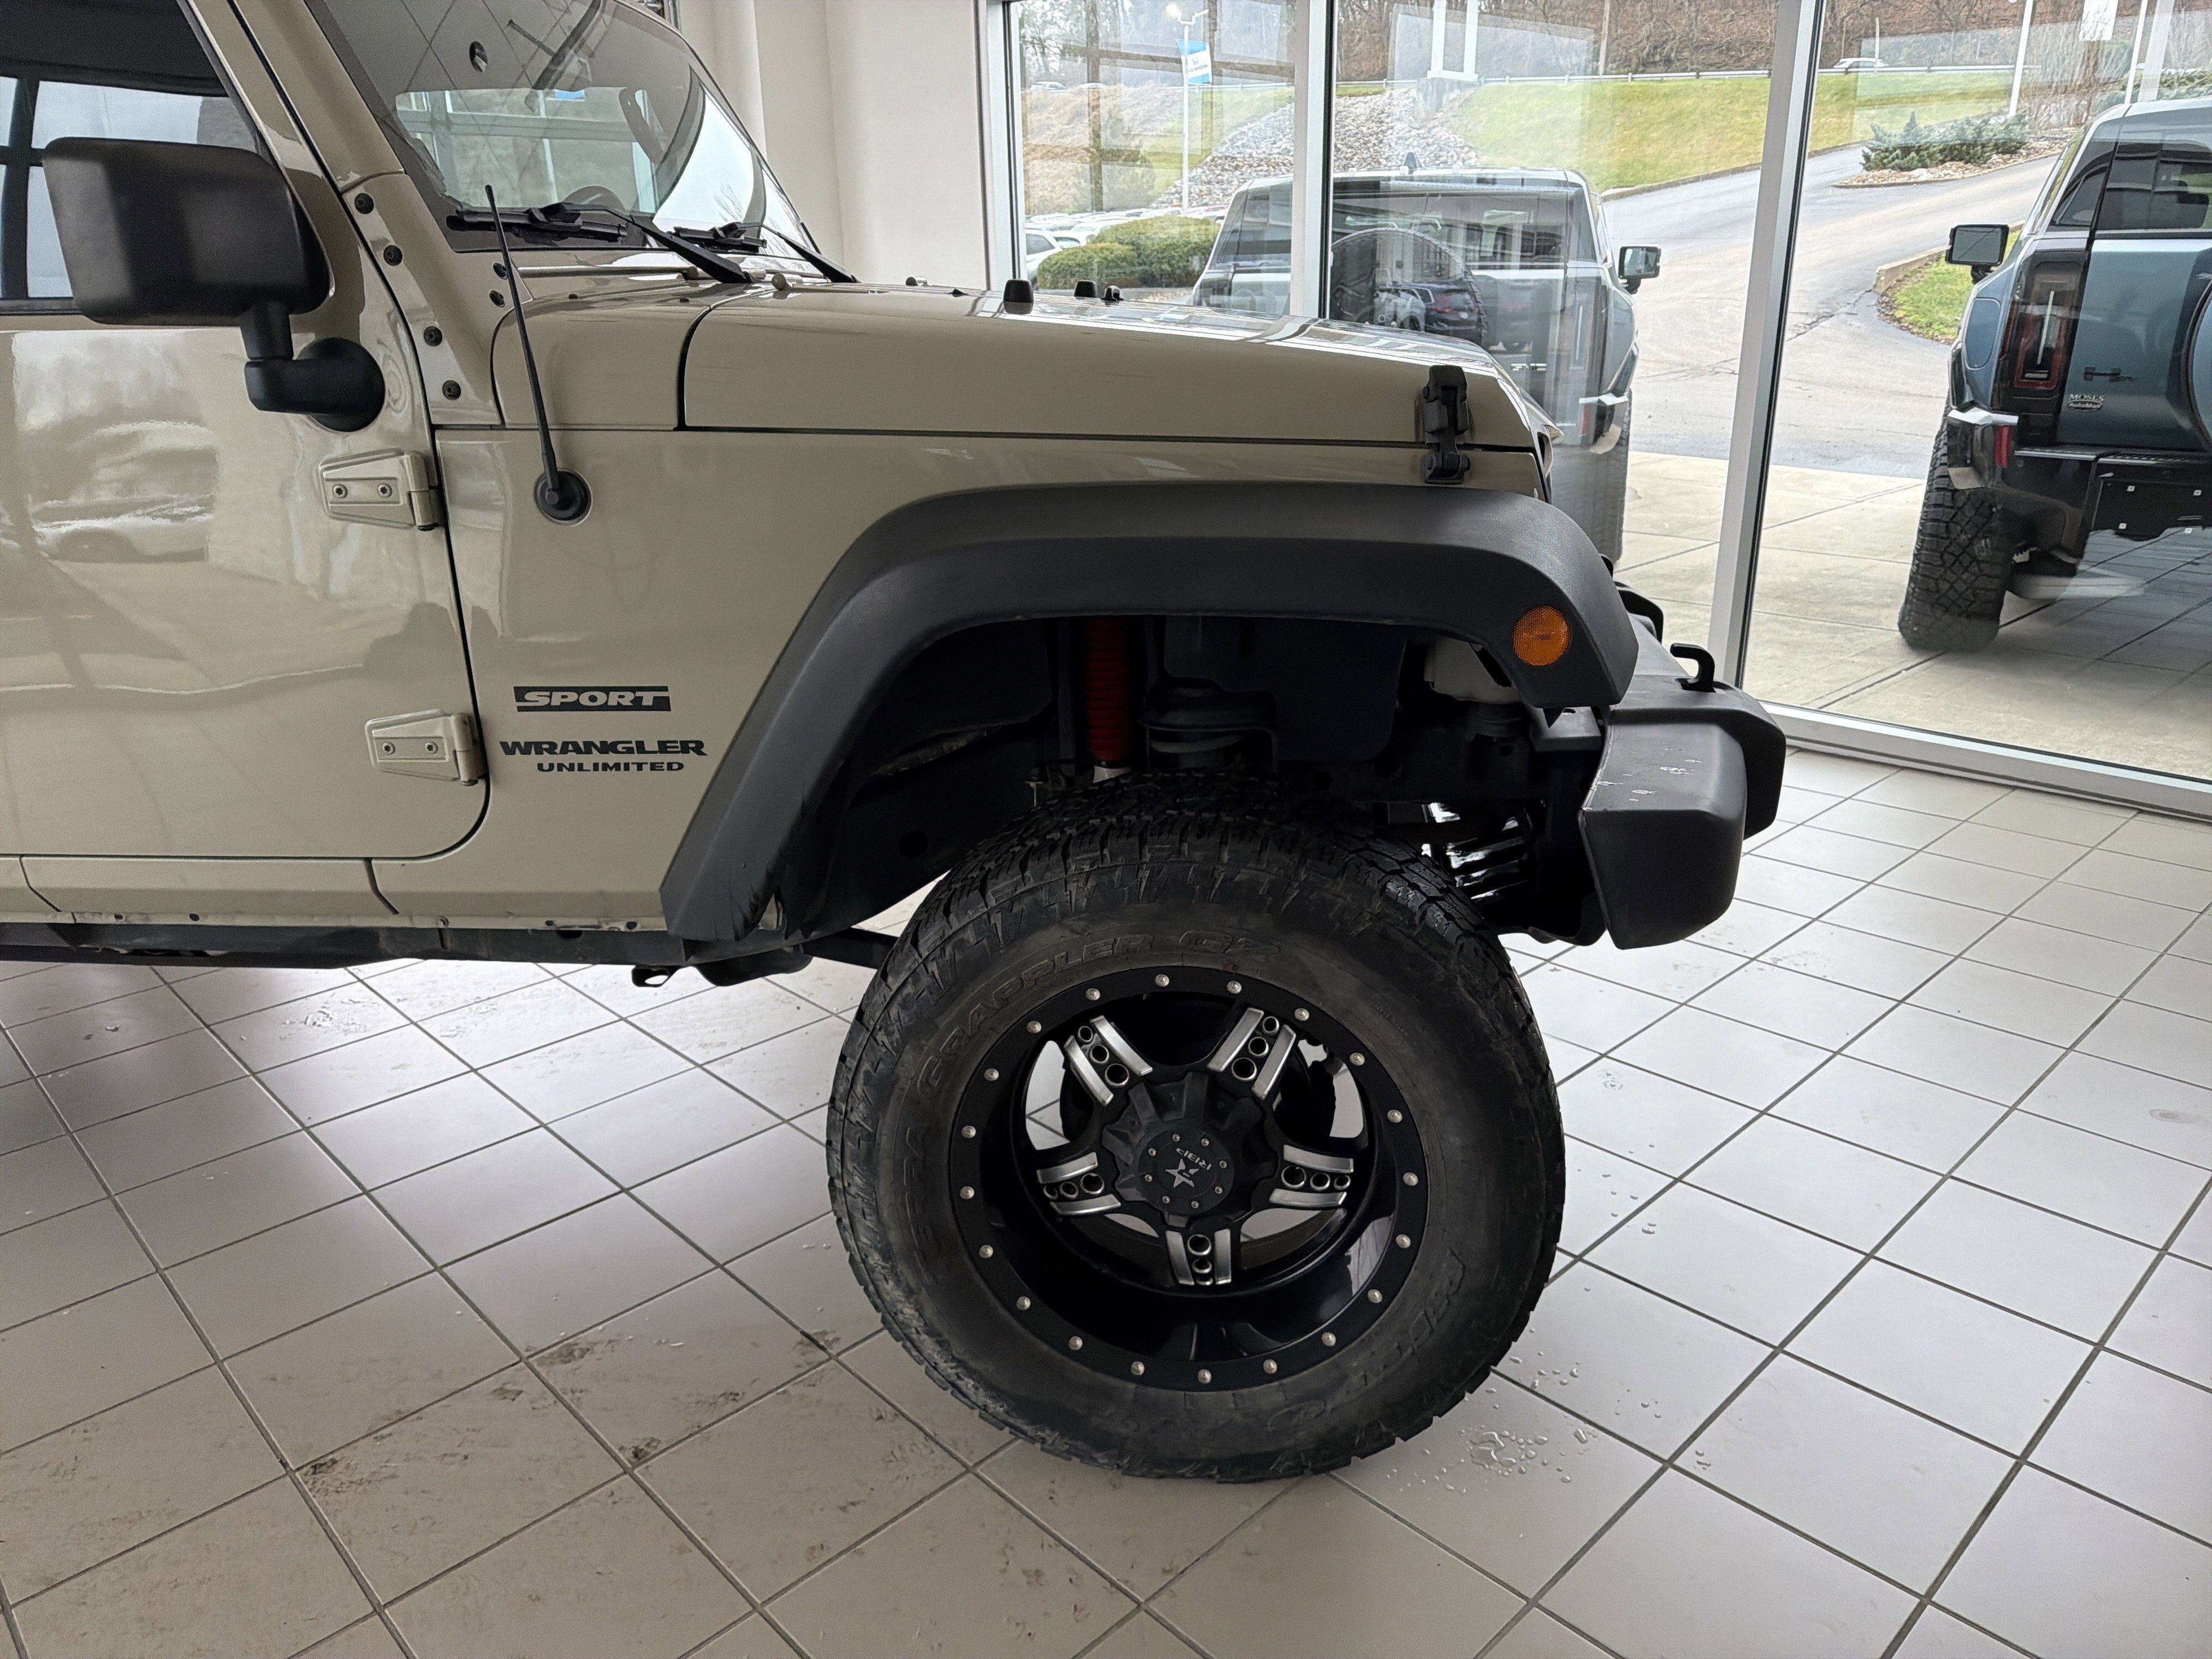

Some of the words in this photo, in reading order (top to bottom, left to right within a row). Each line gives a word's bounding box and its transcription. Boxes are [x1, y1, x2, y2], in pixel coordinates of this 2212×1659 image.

[2069, 393, 2105, 402] MOSES
[516, 690, 670, 707] SPORT
[499, 740, 709, 757] WRANGLER
[536, 761, 685, 772] UNLIMITED
[917, 933, 1155, 1096] GRAPPLER
